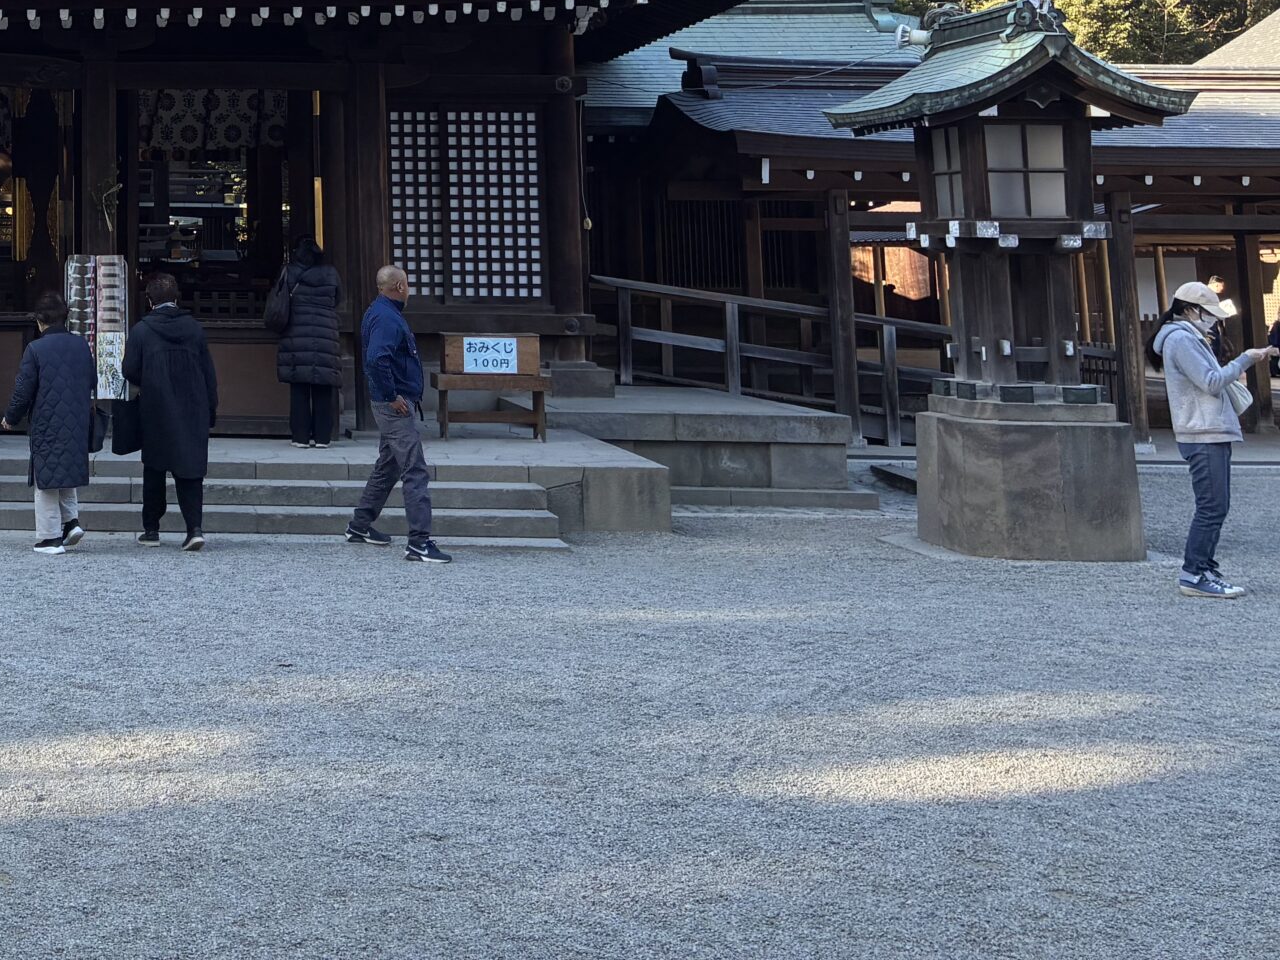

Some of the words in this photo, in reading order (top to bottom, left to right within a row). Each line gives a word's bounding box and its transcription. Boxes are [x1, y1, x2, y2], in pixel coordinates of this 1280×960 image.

[466, 341, 514, 354] おみくじ
[473, 358, 510, 369] 100円
